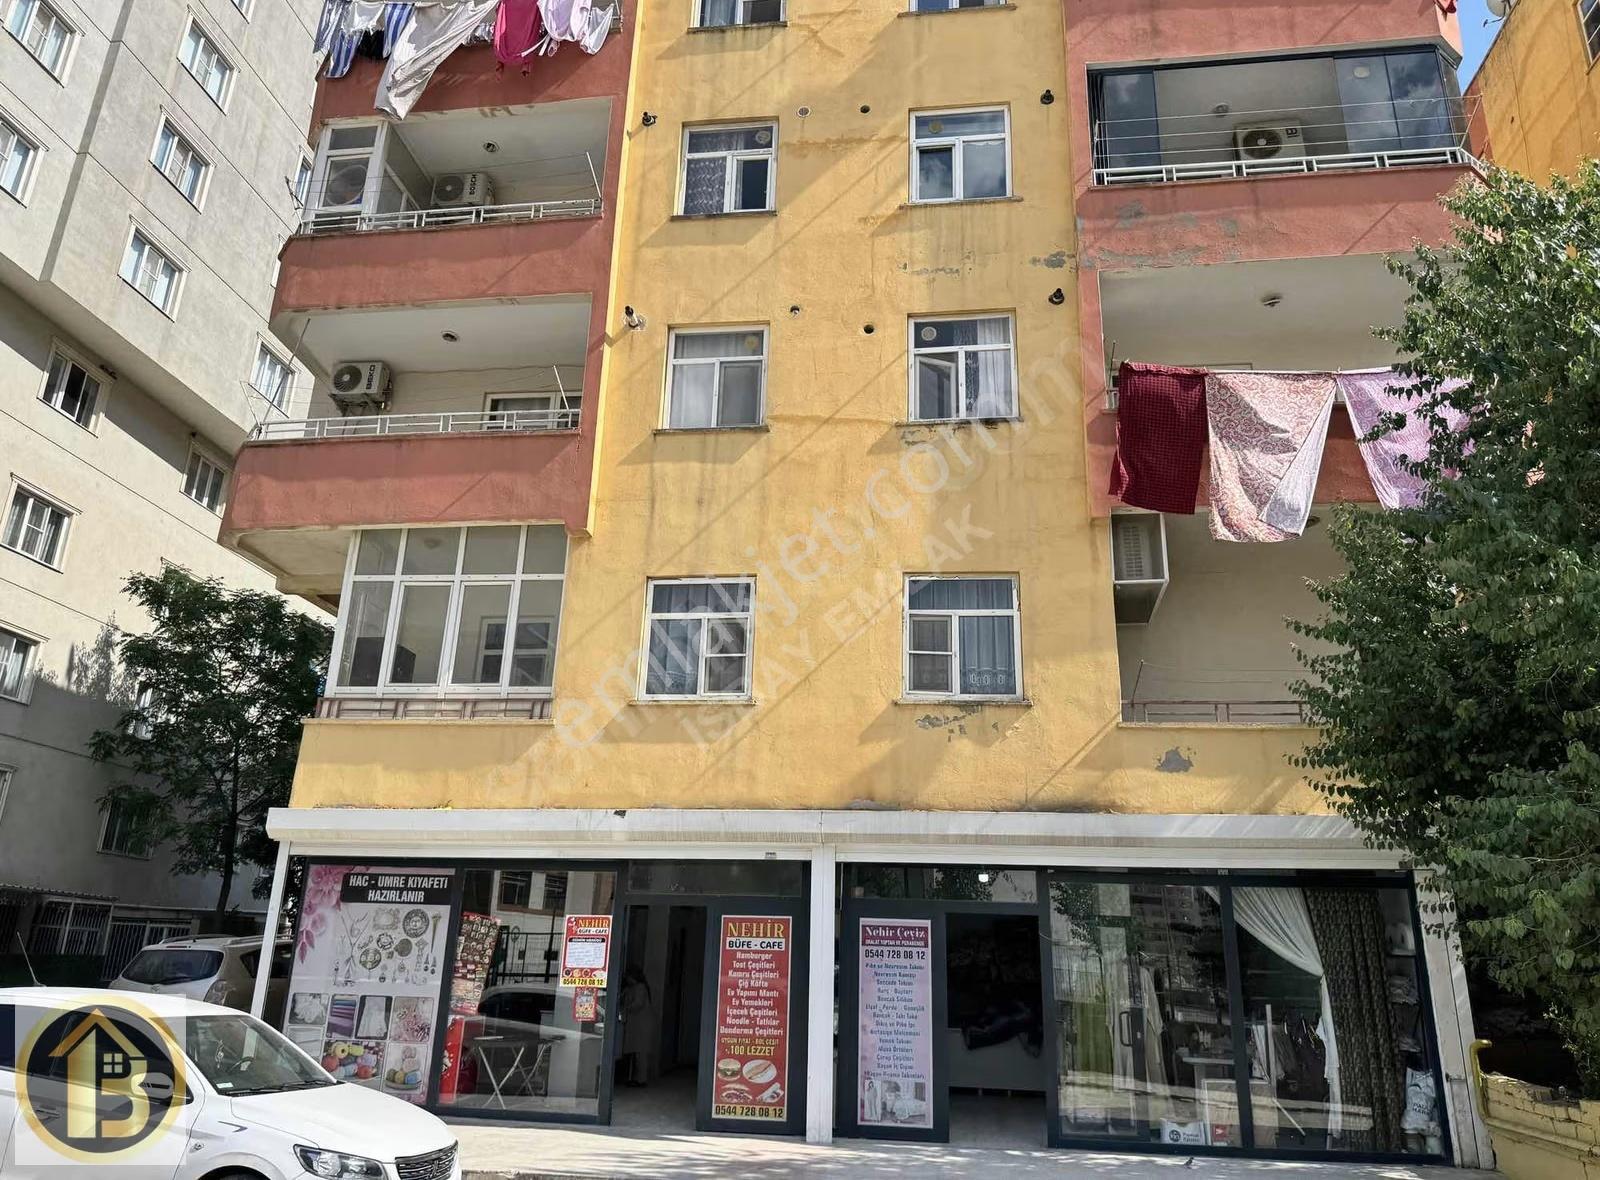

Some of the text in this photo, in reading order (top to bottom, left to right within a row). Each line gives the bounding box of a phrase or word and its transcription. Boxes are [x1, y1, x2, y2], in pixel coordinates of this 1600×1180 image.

[367, 890, 426, 903] HAZIRLANIR
[727, 920, 785, 938] NEHİR
[865, 926, 895, 937] Nehir
[728, 938, 753, 949] BÜFE
[759, 940, 784, 950] CAFE
[864, 949, 884, 959] 0544
[886, 950, 901, 959] 728
[916, 951, 926, 960] 12
[746, 1045, 775, 1056] LEZZET
[715, 1105, 737, 1116] 0544
[773, 1108, 784, 1118] 12
